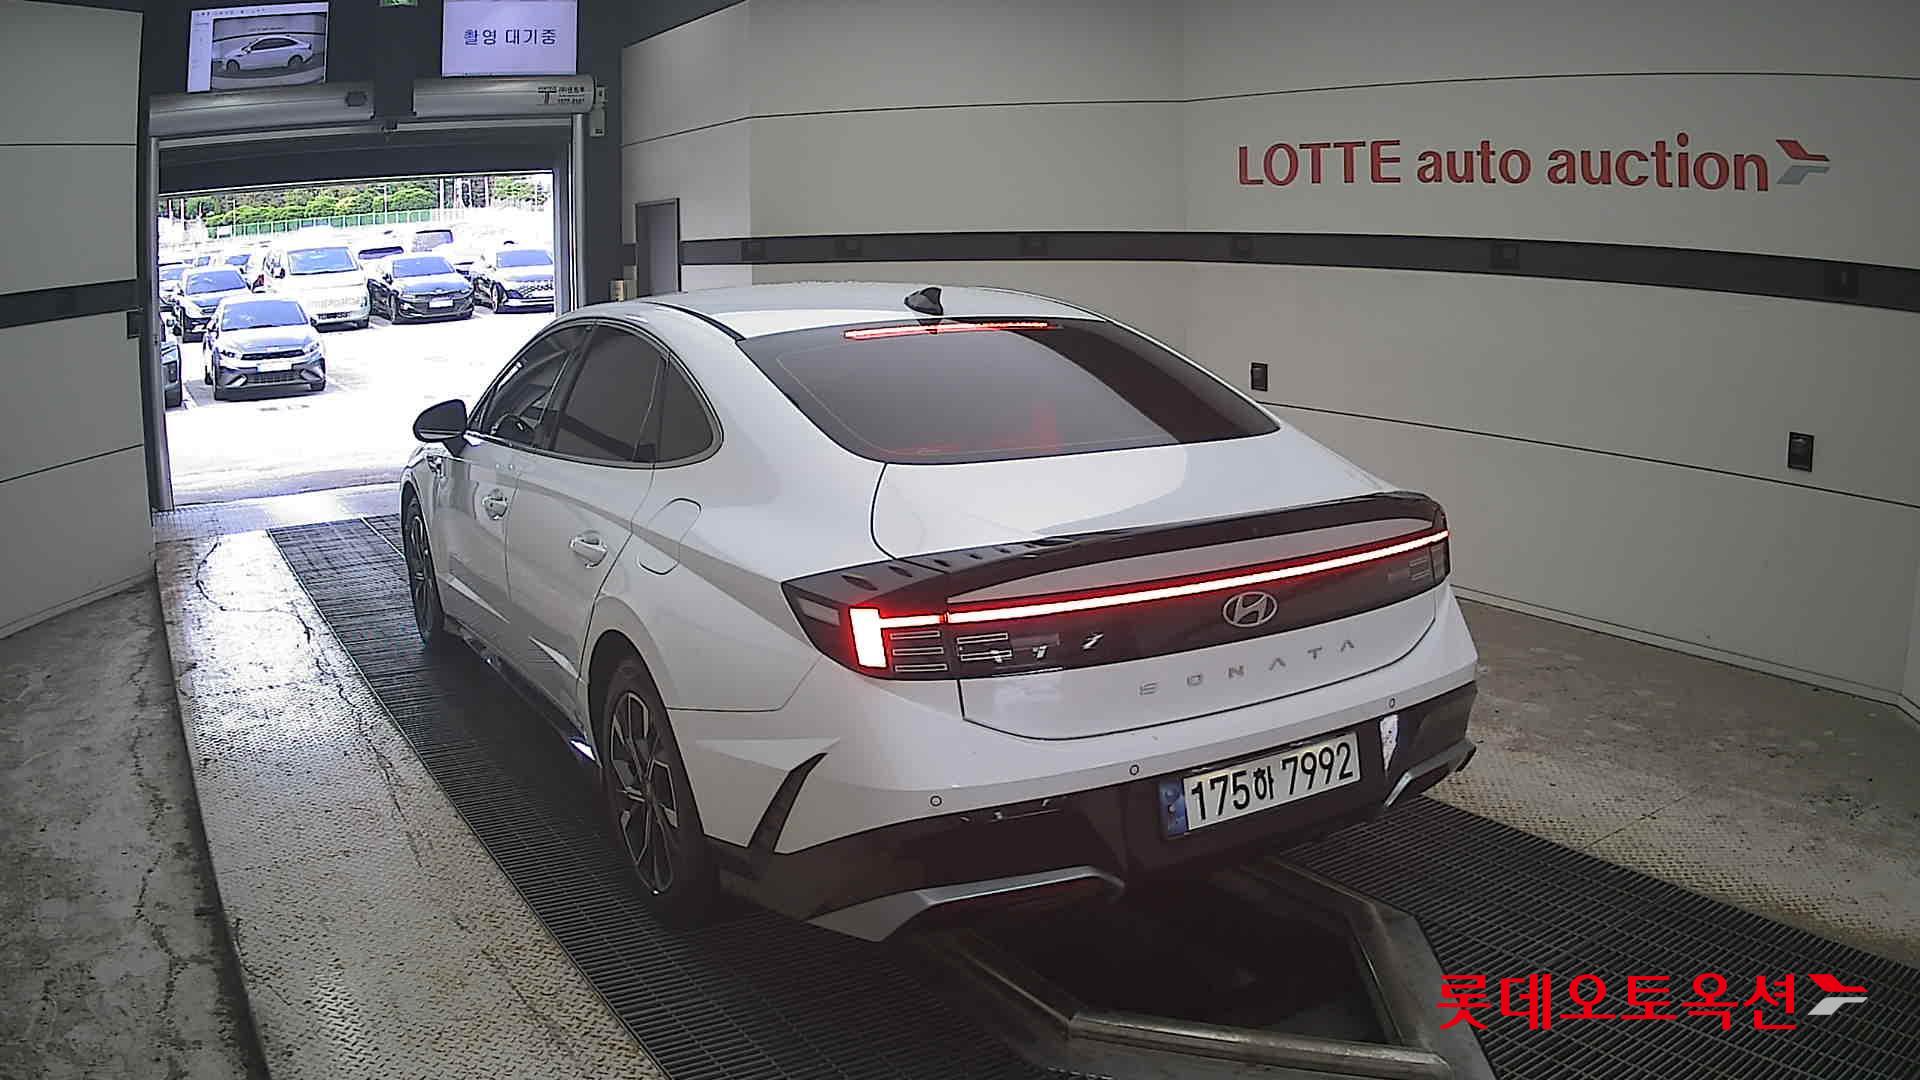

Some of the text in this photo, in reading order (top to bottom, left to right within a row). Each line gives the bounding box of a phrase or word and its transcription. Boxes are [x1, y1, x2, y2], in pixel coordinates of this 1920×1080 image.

[465, 29, 556, 46] 촬영 대기중
[1238, 132, 1768, 192] LOTTE auto auction
[1139, 639, 1355, 696] SONATA
[1191, 741, 1353, 820] 175하 7992
